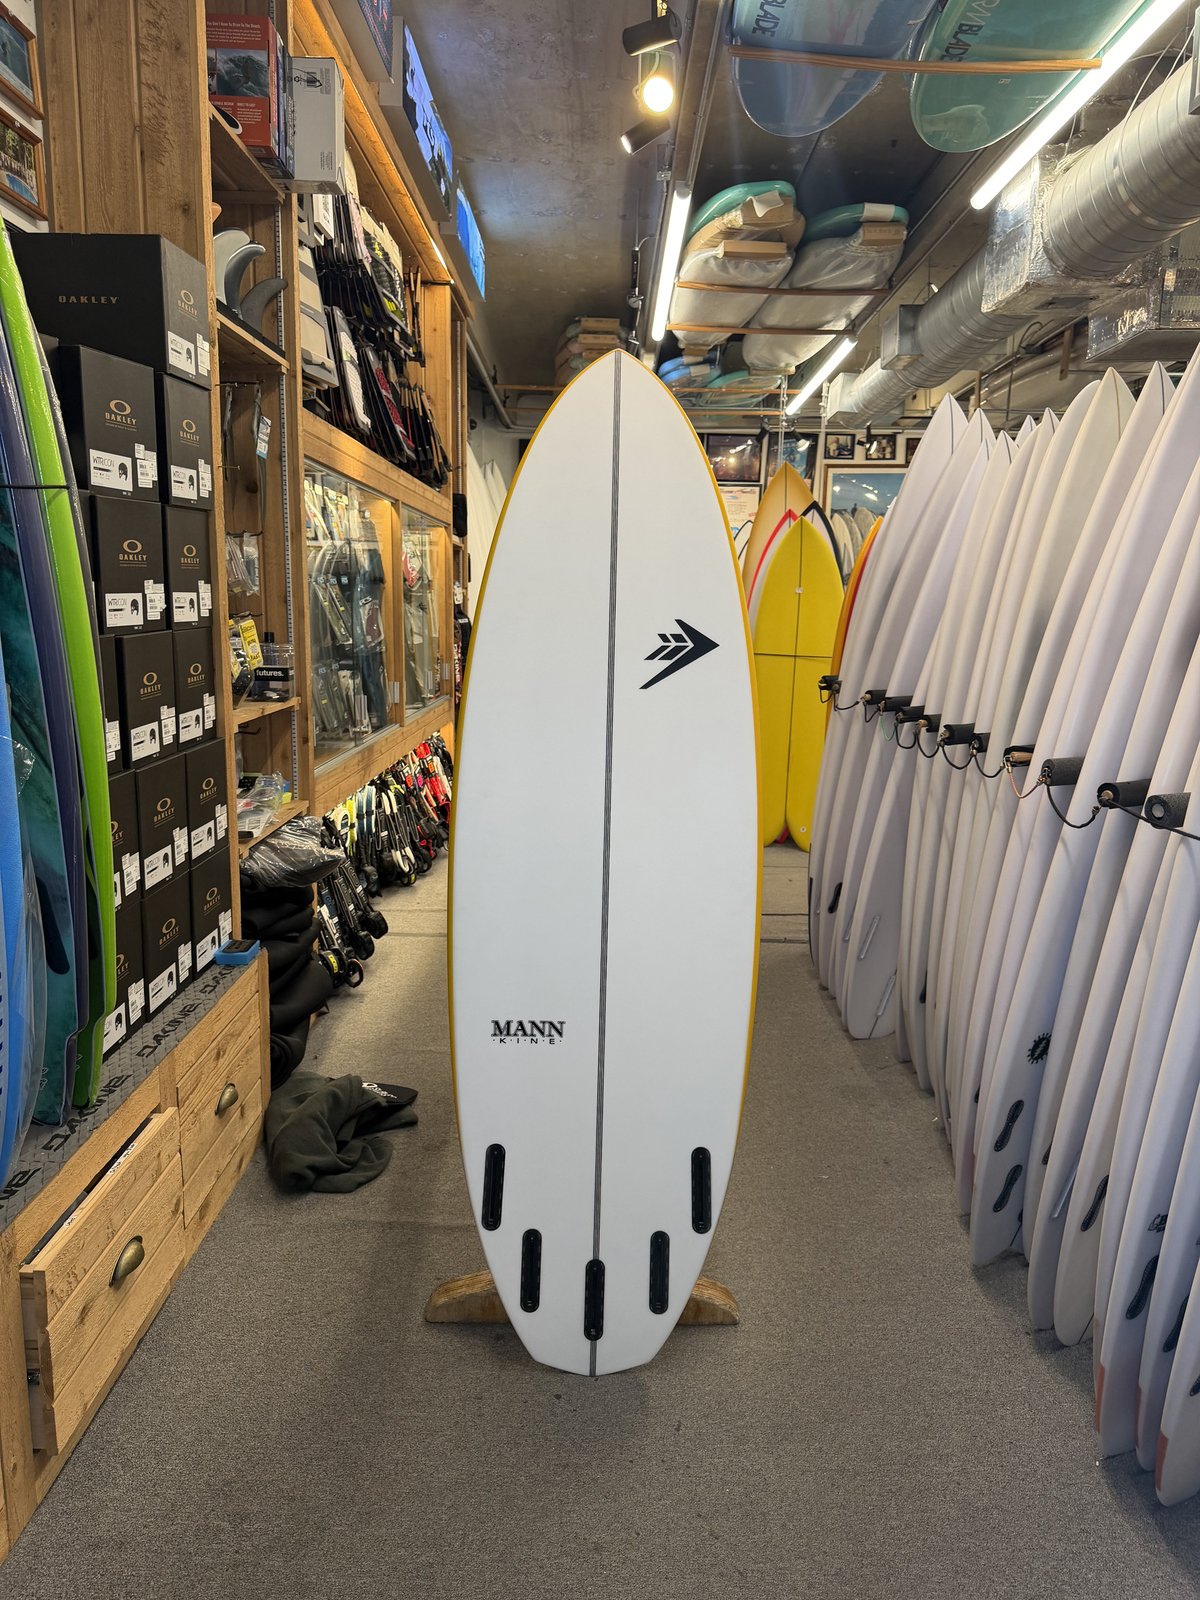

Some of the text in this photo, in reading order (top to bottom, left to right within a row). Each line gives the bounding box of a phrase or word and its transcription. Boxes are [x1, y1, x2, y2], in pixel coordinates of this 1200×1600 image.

[58, 295, 119, 304] OAKLEY
[177, 300, 198, 317] OAKLEY
[105, 412, 137, 426] OAKLEY
[180, 430, 200, 442] OAKLEY
[118, 553, 148, 561] OAKLEY
[187, 674, 206, 684] OAKLEY
[256, 669, 285, 677] futures.
[140, 684, 162, 695] OAKLEY
[153, 807, 176, 823] OAKLEY
[159, 926, 180, 945] OAKLEY
[490, 1019, 566, 1038] MANN
